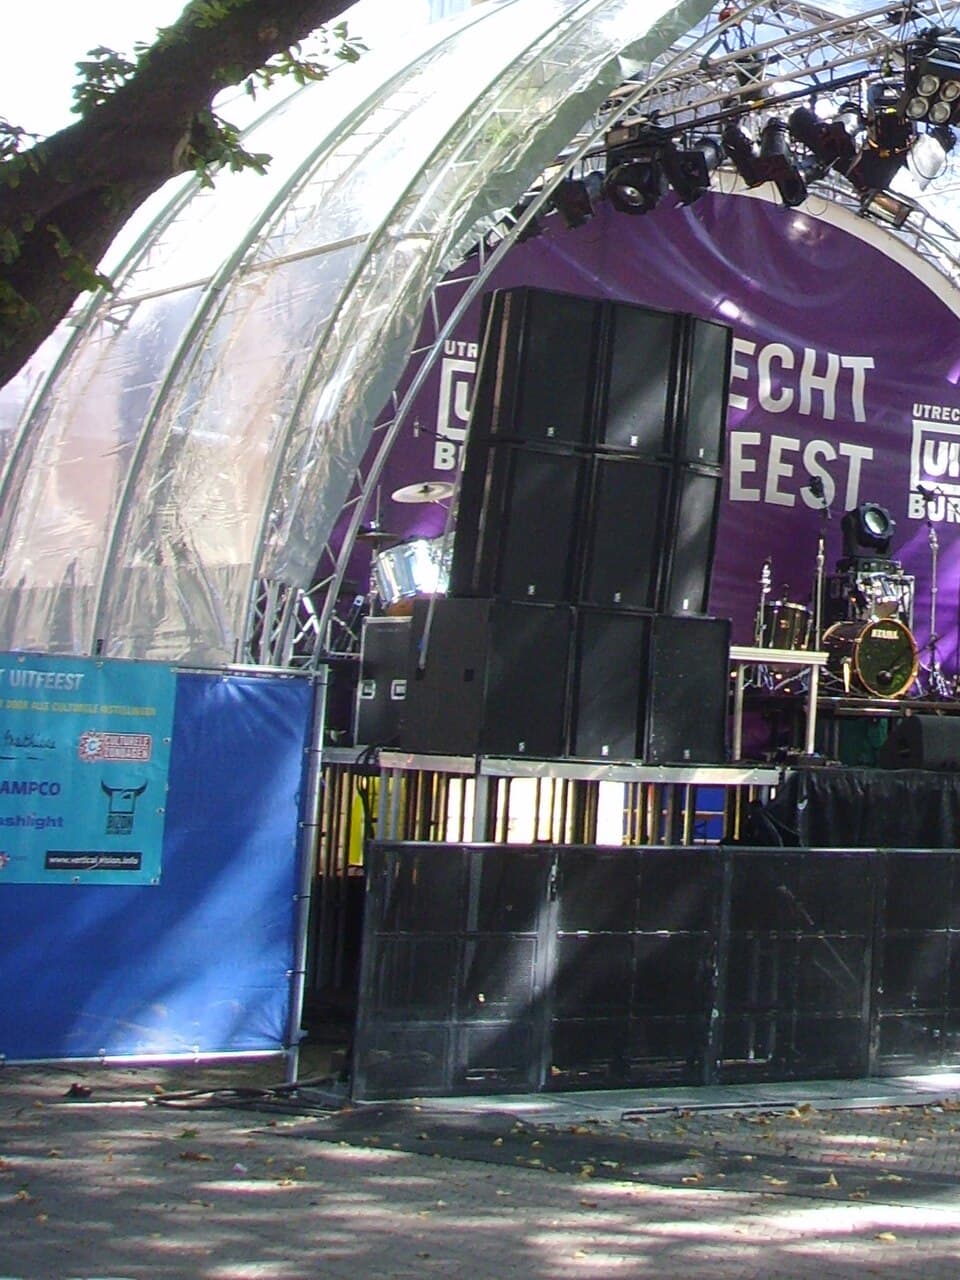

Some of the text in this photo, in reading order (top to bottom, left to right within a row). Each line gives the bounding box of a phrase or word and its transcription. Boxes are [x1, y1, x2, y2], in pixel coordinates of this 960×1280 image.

[729, 338, 875, 422] ECHT
[729, 431, 874, 512] EEST
[9, 670, 85, 691] UITFEEST
[0, 780, 61, 796] AMPCO
